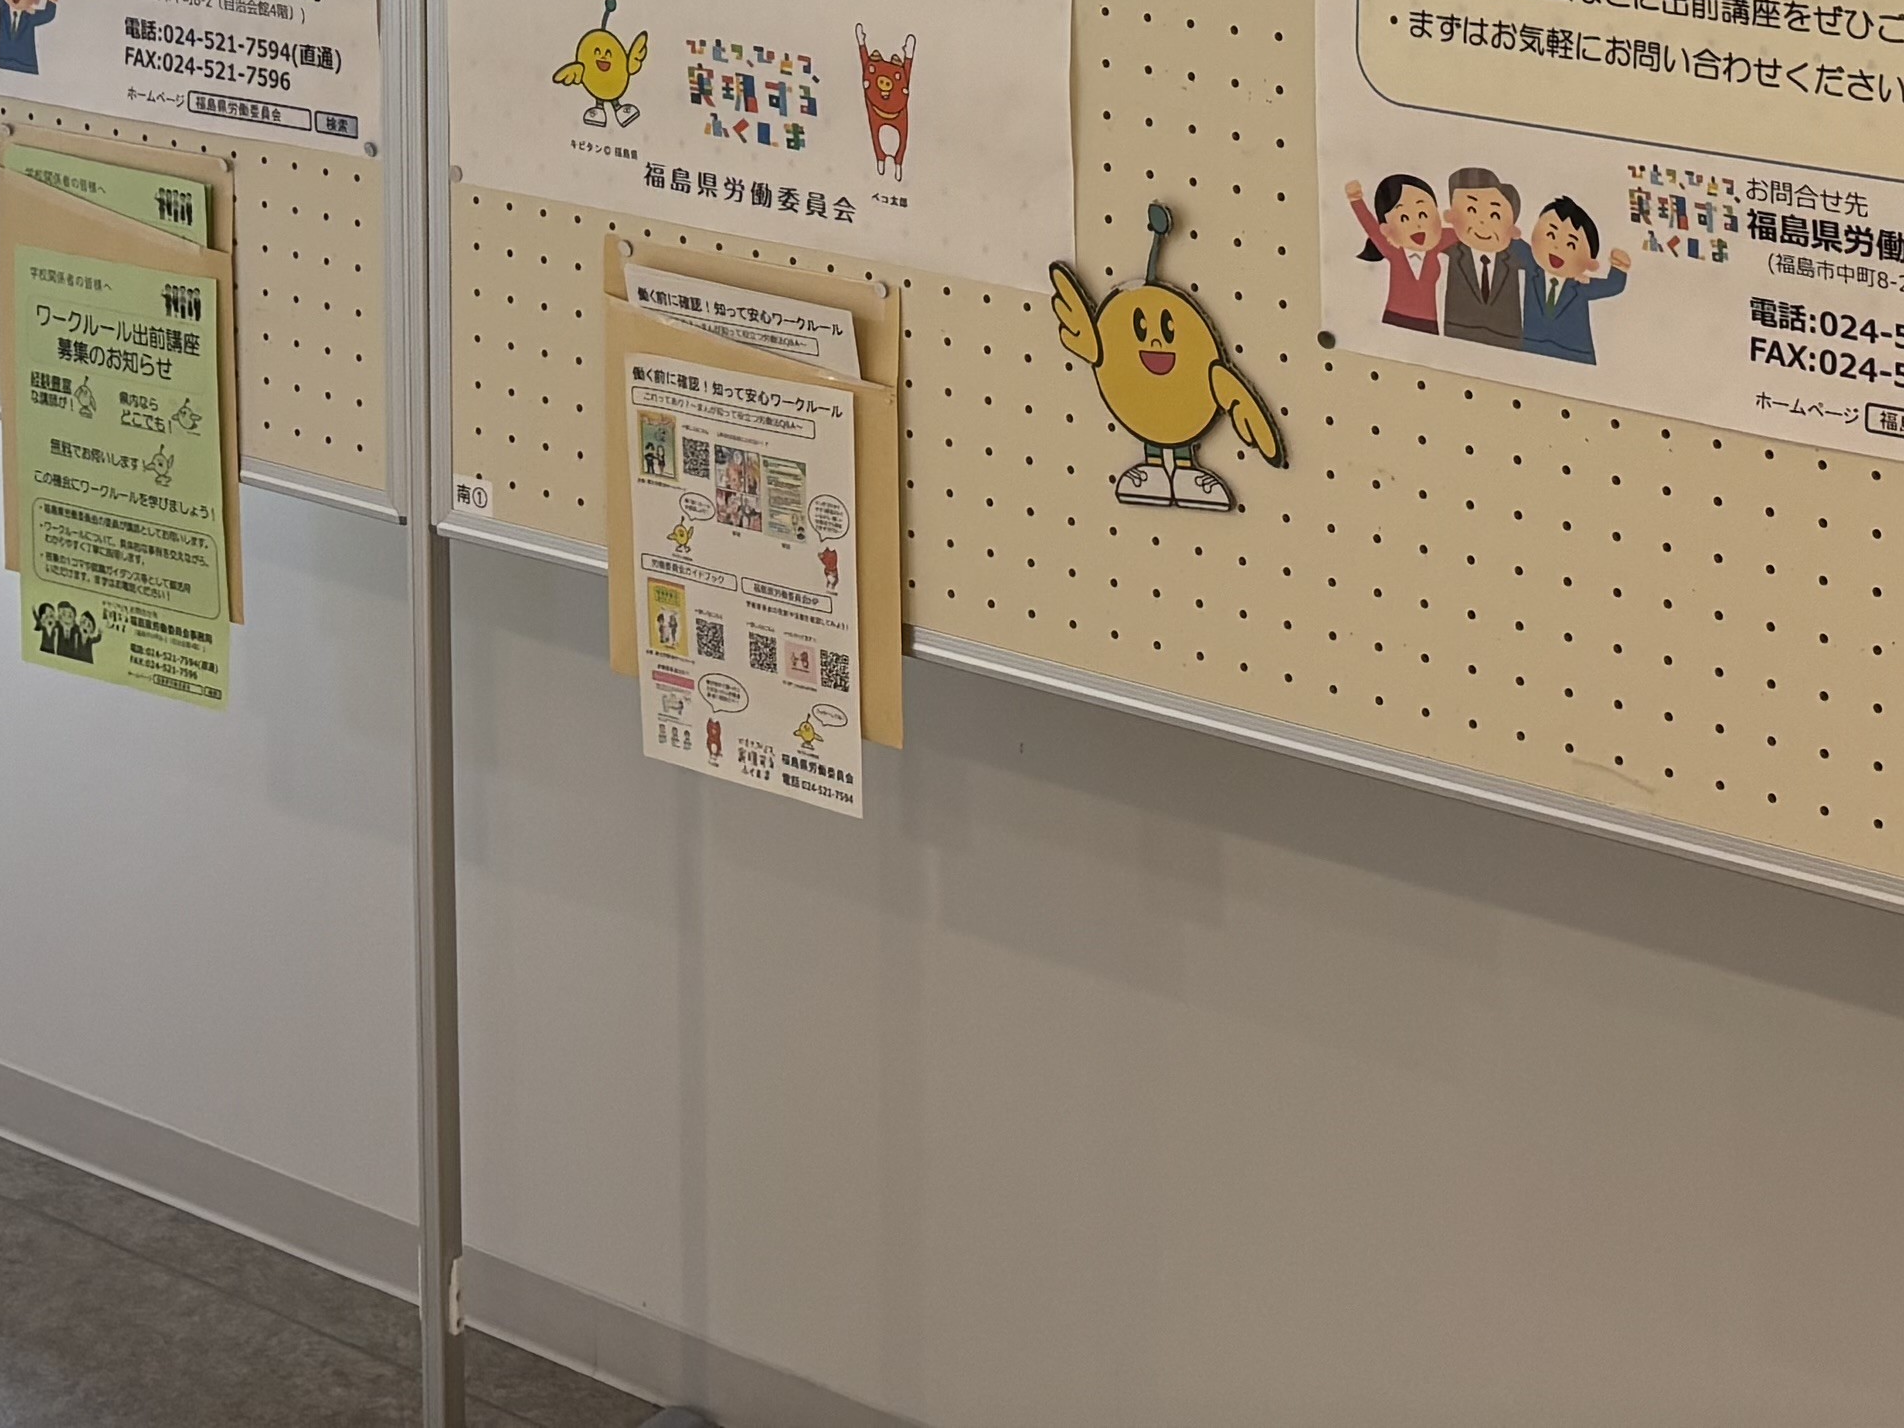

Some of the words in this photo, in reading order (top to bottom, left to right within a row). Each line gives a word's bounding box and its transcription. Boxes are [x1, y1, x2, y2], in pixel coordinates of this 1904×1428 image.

[124, 46, 291, 91] FAX:024-521-7596
[126, 85, 186, 108] ホームページ
[195, 94, 282, 124] 福島県労働委員会
[644, 161, 857, 224] 福島県労働委員会
[1746, 177, 1868, 217] お問合せ先
[36, 303, 201, 358] ワークルール出前講座
[57, 337, 172, 380] 募集のお知らせ
[632, 365, 843, 418] 働く前に確認！知って安心ワークルール
[1754, 389, 1860, 428] ホームページ
